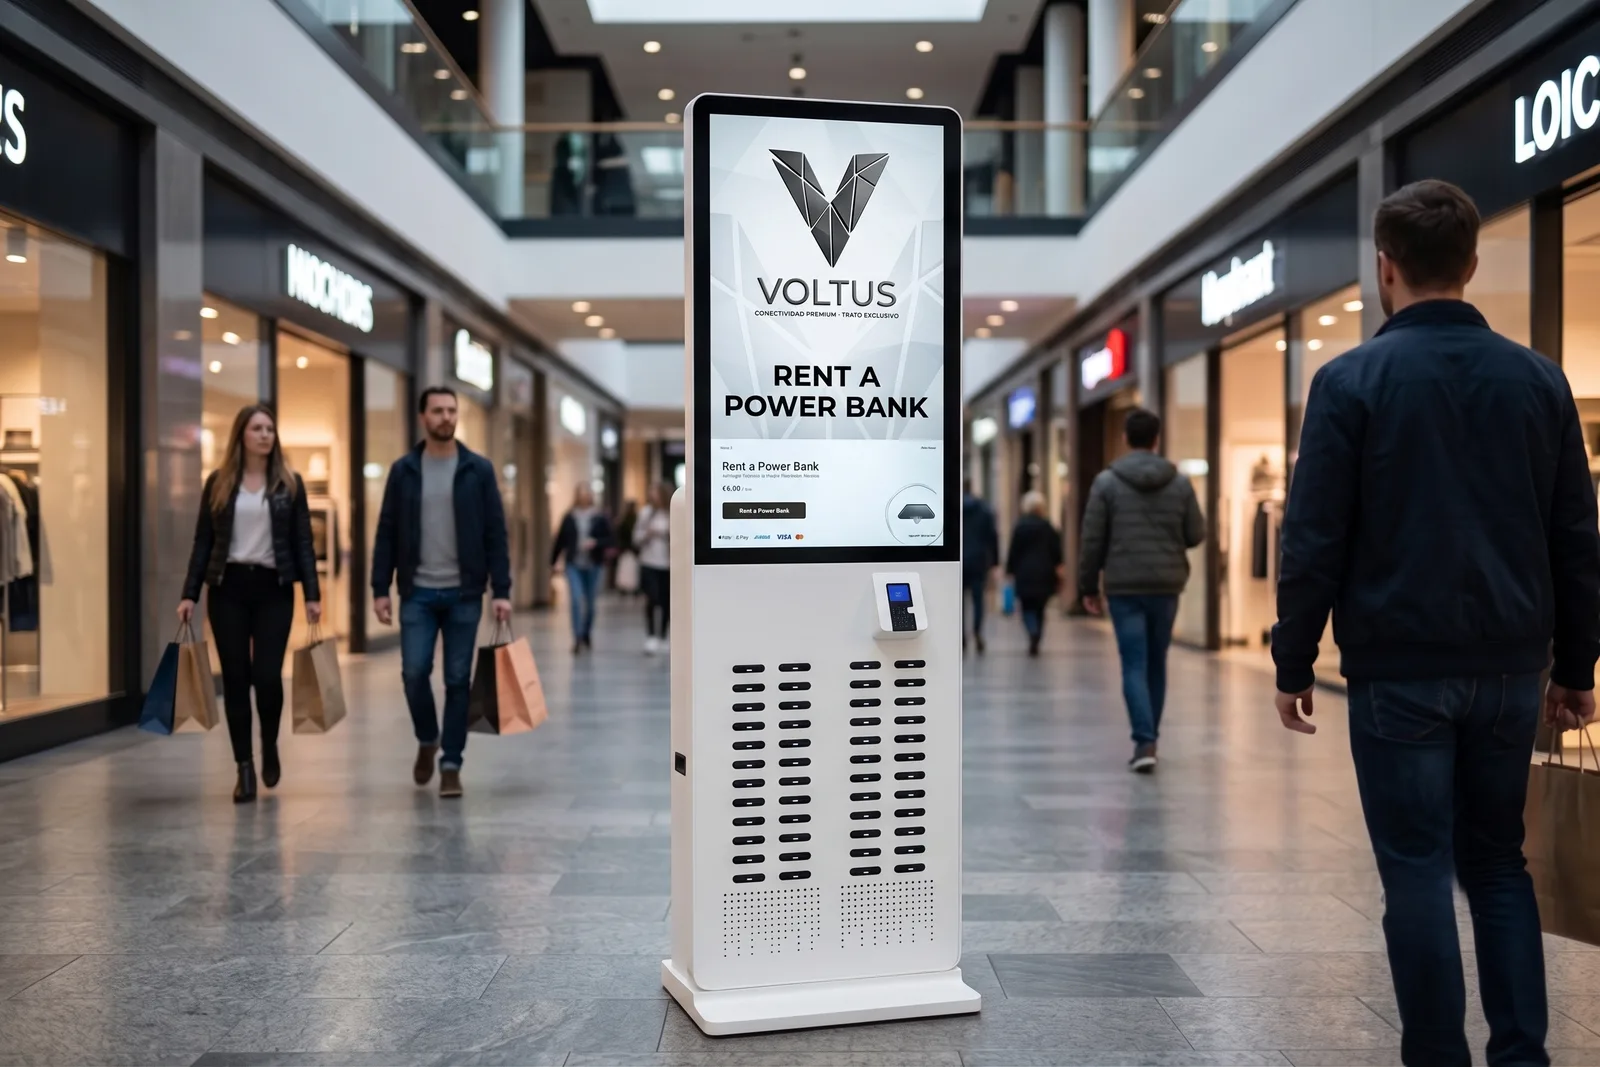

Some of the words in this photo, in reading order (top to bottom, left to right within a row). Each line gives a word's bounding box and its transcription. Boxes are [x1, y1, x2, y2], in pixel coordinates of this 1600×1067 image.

[0, 83, 27, 165] S
[757, 277, 897, 308] VOLTUS
[754, 310, 805, 318] CONECTIVIDAD
[774, 365, 851, 387] RENT
[859, 366, 881, 388] A
[725, 395, 837, 418] POWER
[846, 396, 929, 418] BANK
[722, 461, 746, 472] Rent
[748, 463, 755, 472] a
[758, 461, 791, 472] Power
[793, 461, 819, 472] Bank
[777, 533, 792, 541] VISA
